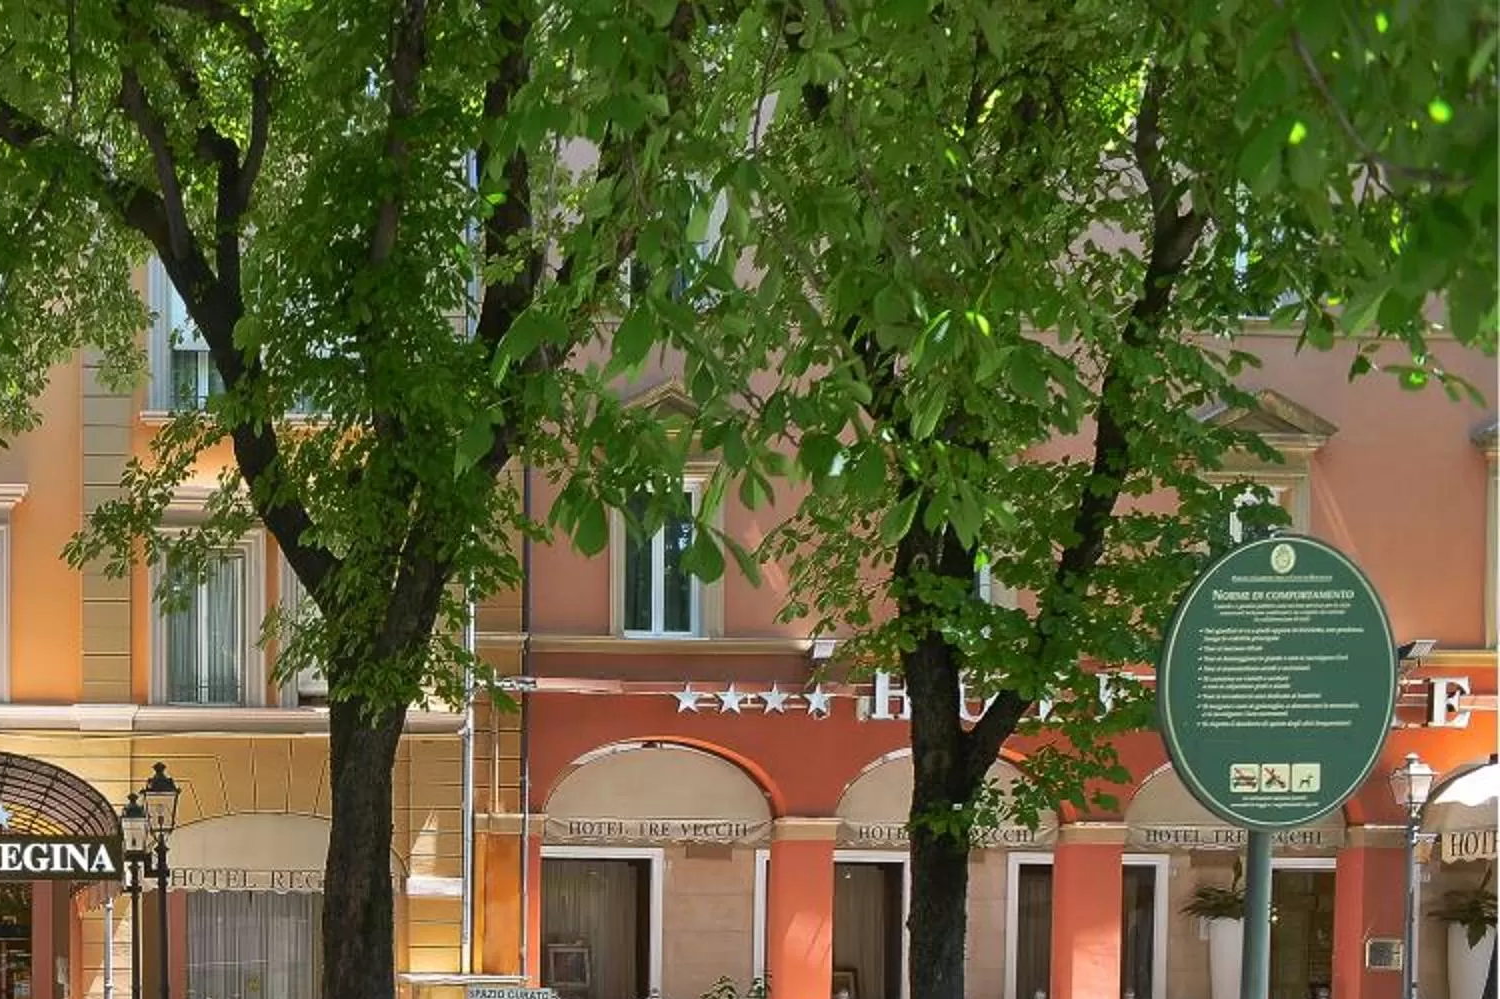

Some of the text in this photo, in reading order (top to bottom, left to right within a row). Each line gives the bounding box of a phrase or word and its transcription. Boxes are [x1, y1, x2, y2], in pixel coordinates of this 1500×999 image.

[569, 821, 748, 837] HOTEL TRE VECCHI
[171, 869, 324, 889] HOTEL REG
[469, 989, 549, 999] SPAZIO CURATO
